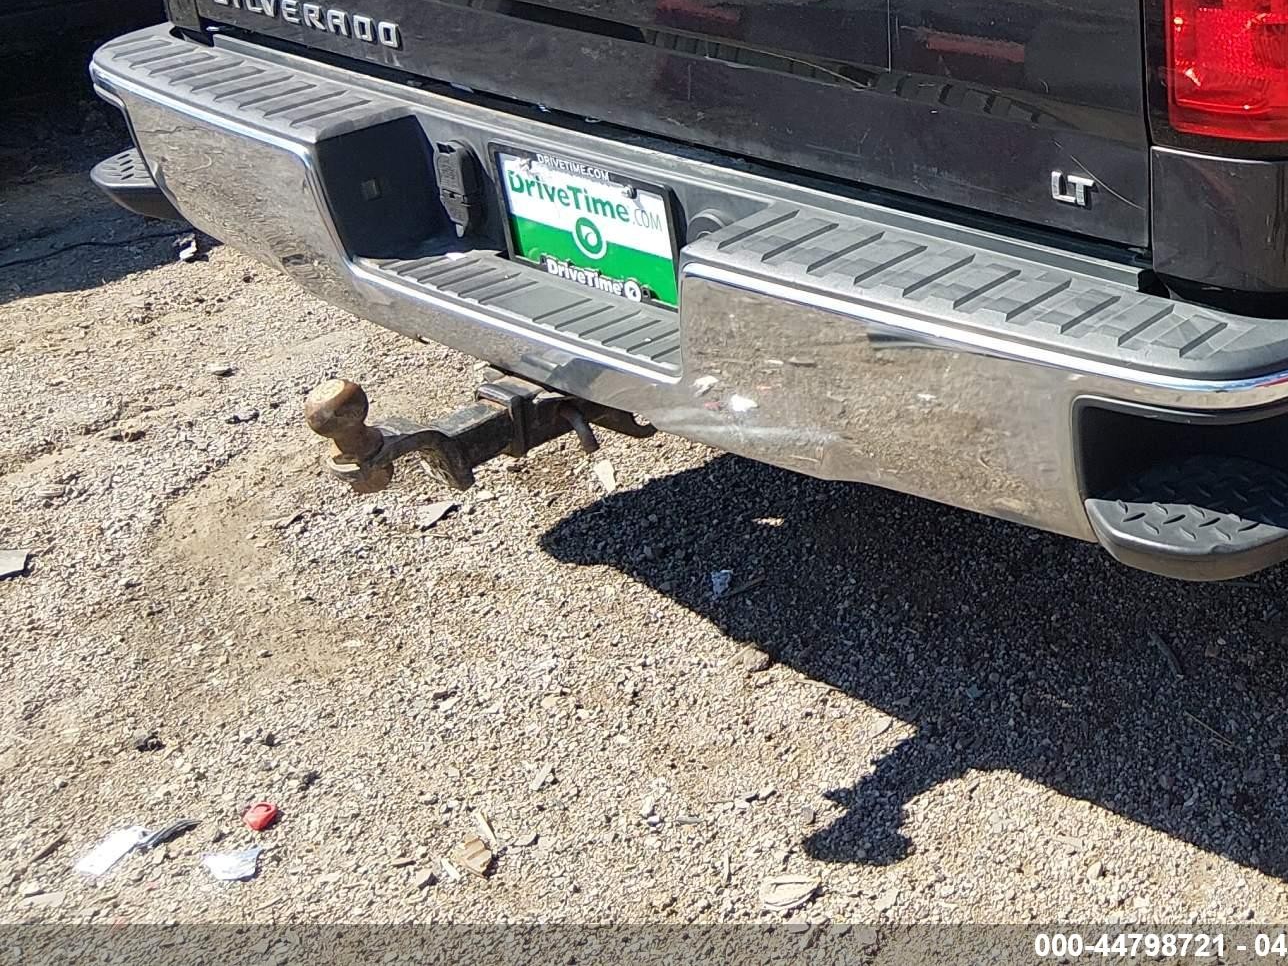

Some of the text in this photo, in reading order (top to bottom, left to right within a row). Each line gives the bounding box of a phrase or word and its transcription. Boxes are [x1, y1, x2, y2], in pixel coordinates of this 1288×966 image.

[537, 153, 610, 182] DRIVETIME.COM
[1051, 170, 1095, 206] LT
[546, 258, 624, 297] DriveTime
